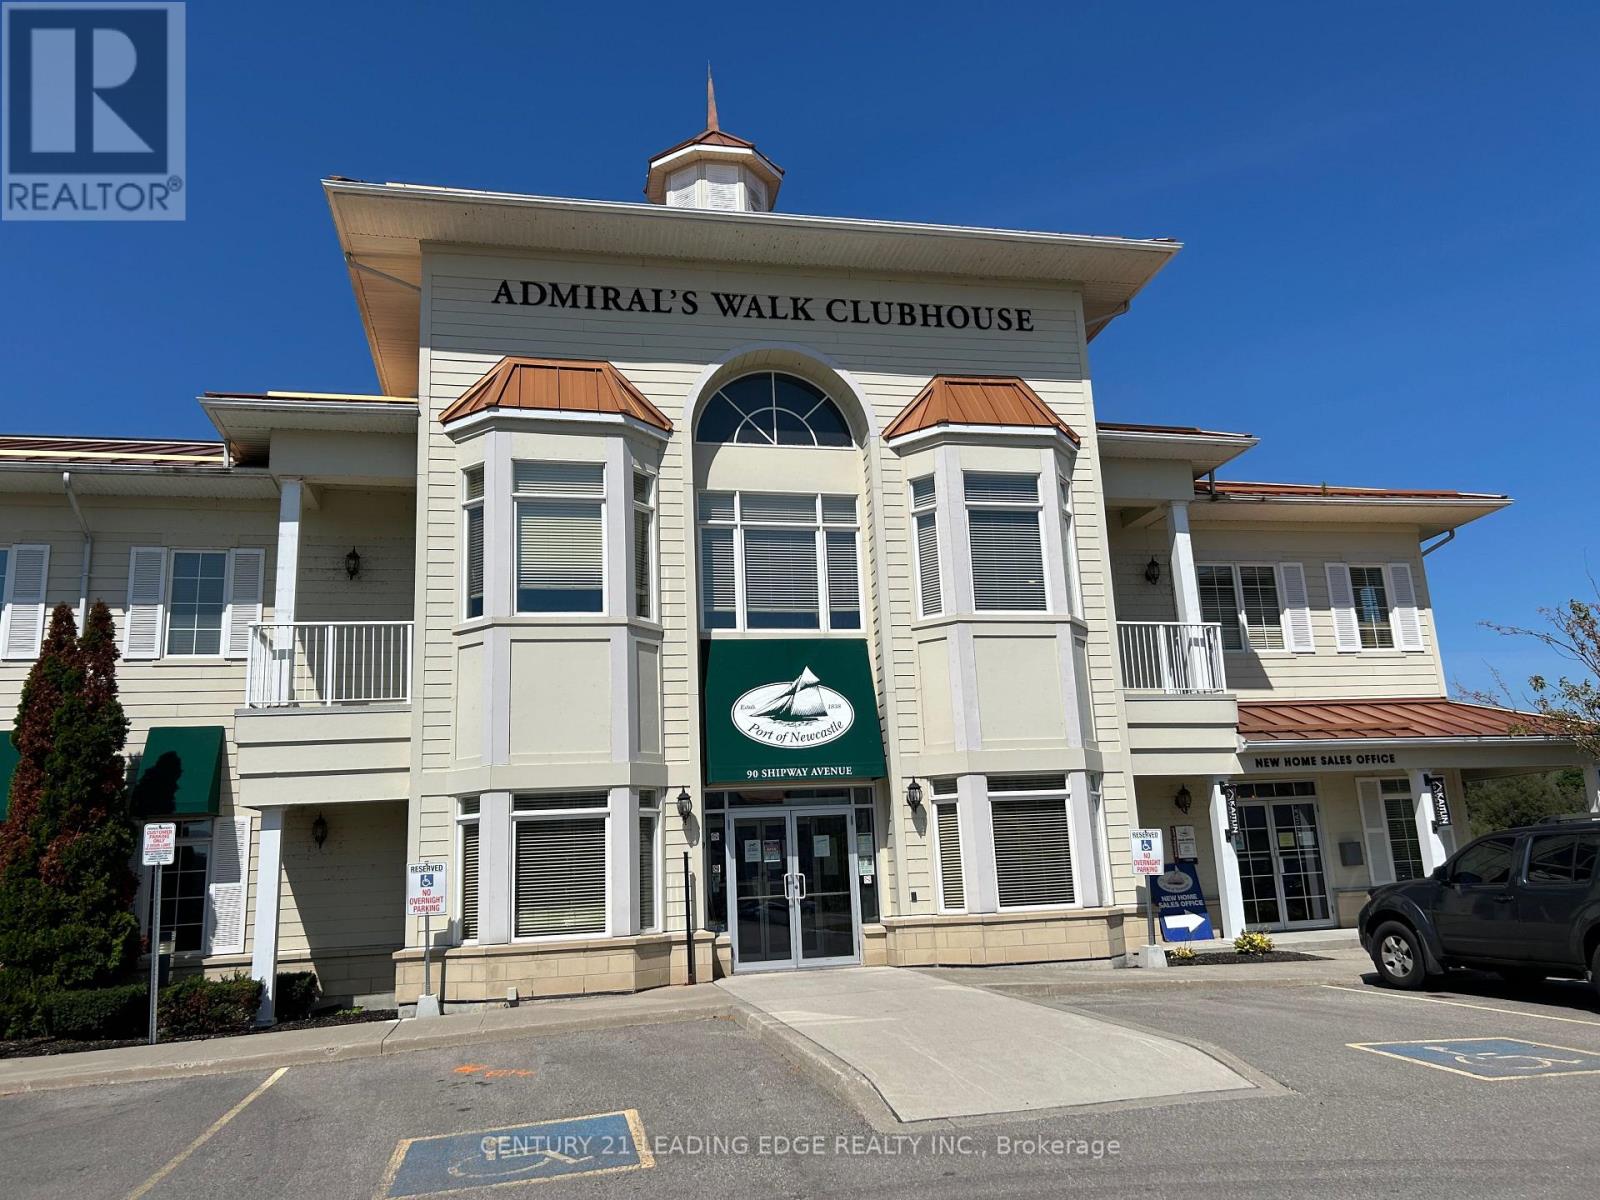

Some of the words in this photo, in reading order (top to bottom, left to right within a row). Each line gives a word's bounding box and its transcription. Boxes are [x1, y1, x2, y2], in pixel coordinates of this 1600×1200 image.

[491, 279, 698, 315] ADMIRAL'S
[711, 291, 815, 321] WALK
[825, 298, 1035, 332] CLUBHOUSE
[747, 722, 775, 740] Port
[775, 731, 789, 744] of
[790, 720, 844, 743] Newcastle
[1255, 757, 1280, 768] NEW
[1284, 756, 1317, 767] HOME
[1320, 755, 1353, 766] SALES
[1356, 753, 1396, 764] OFFICE
[746, 769, 759, 779] 90
[761, 767, 809, 778] SHIPWAY
[811, 765, 853, 776] AVENUE
[1436, 792, 1449, 824] KAITLIN
[1230, 800, 1239, 833] KAITLIN
[411, 865, 443, 873] RESERVED
[409, 896, 444, 906] OVERNIGHT
[1158, 901, 1180, 909] SALES
[1180, 899, 1204, 907] OFFICE
[1161, 894, 1177, 902] NEW
[1177, 893, 1198, 901] HOME
